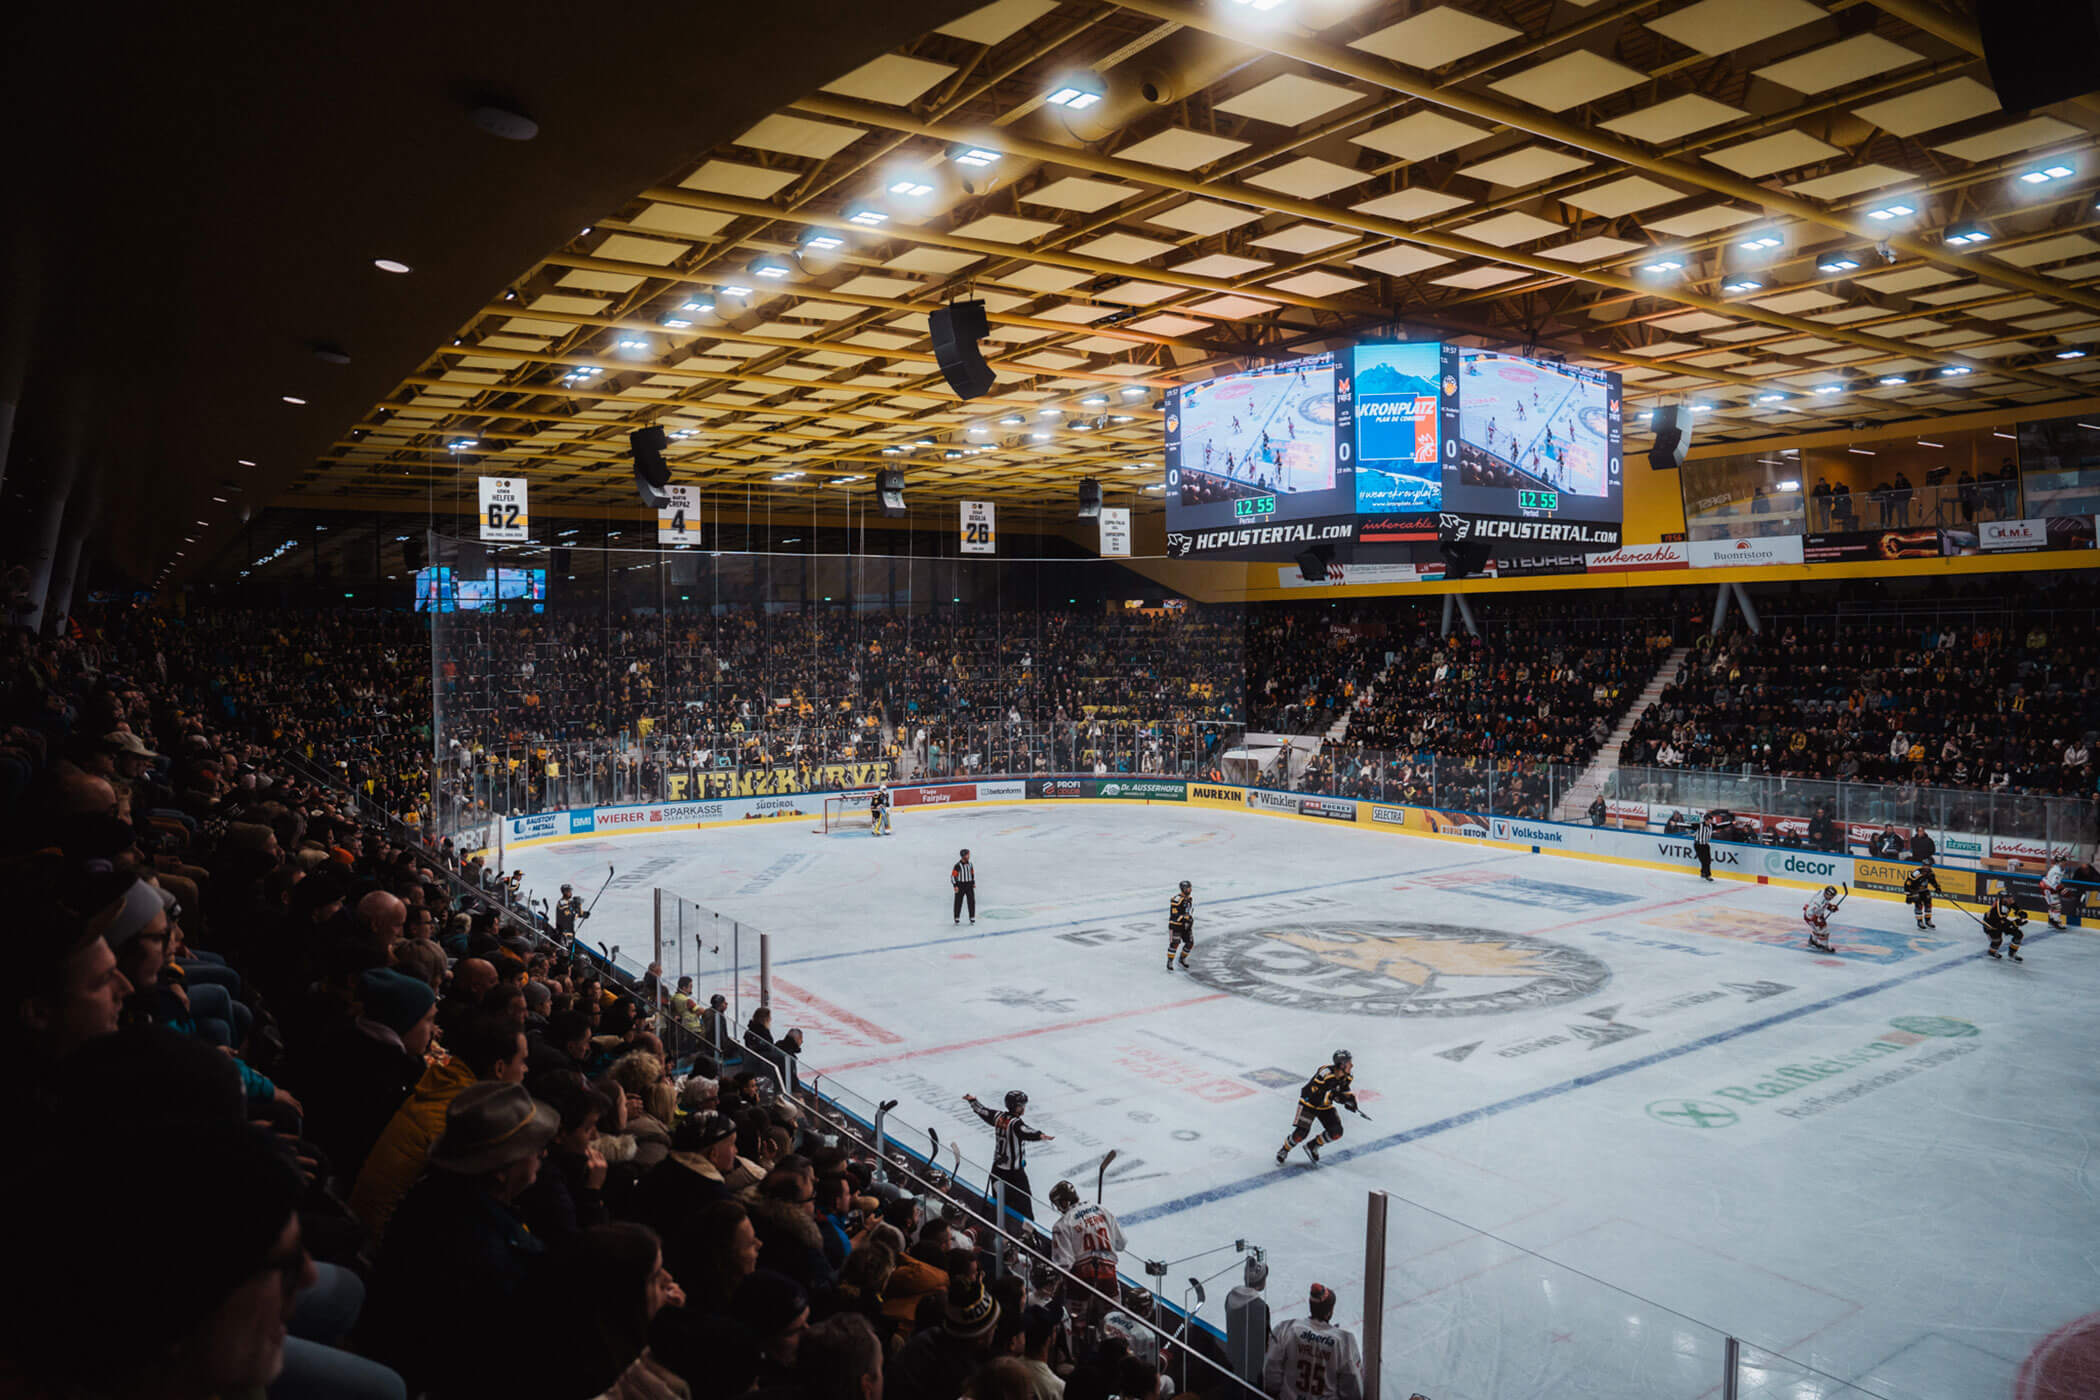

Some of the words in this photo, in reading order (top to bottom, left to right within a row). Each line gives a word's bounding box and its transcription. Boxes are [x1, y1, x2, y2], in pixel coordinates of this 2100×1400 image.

[1360, 401, 1434, 416] KRONPLATZ
[1338, 442, 1350, 461] 0
[1446, 440, 1456, 458] 0
[1610, 457, 1619, 475] 0
[1169, 469, 1178, 486] 0
[488, 503, 520, 529] 62
[671, 509, 686, 534] 4
[966, 522, 989, 544] 26
[1196, 523, 1352, 550] HCPUSTERTAL.COM
[1474, 519, 1618, 544] HCPUSTERTAL.COM
[1593, 545, 1681, 565] intercable
[1713, 551, 1773, 561] Buonristoro
[1131, 784, 1185, 793] AUSSERHOFER
[1193, 788, 1242, 801] MUREXIN
[1260, 792, 1297, 808] Winkler
[597, 811, 645, 826] WIERER
[663, 804, 723, 817] SPARKASSE
[1374, 807, 1403, 823] SELECTRA
[1511, 827, 1562, 843] Volksbank
[1657, 843, 1740, 865] VITRUX
[1784, 856, 1836, 876] decor
[1074, 1204, 1100, 1220] alperia
[1299, 1329, 1336, 1347] alperia
[1296, 1360, 1326, 1395] 35
